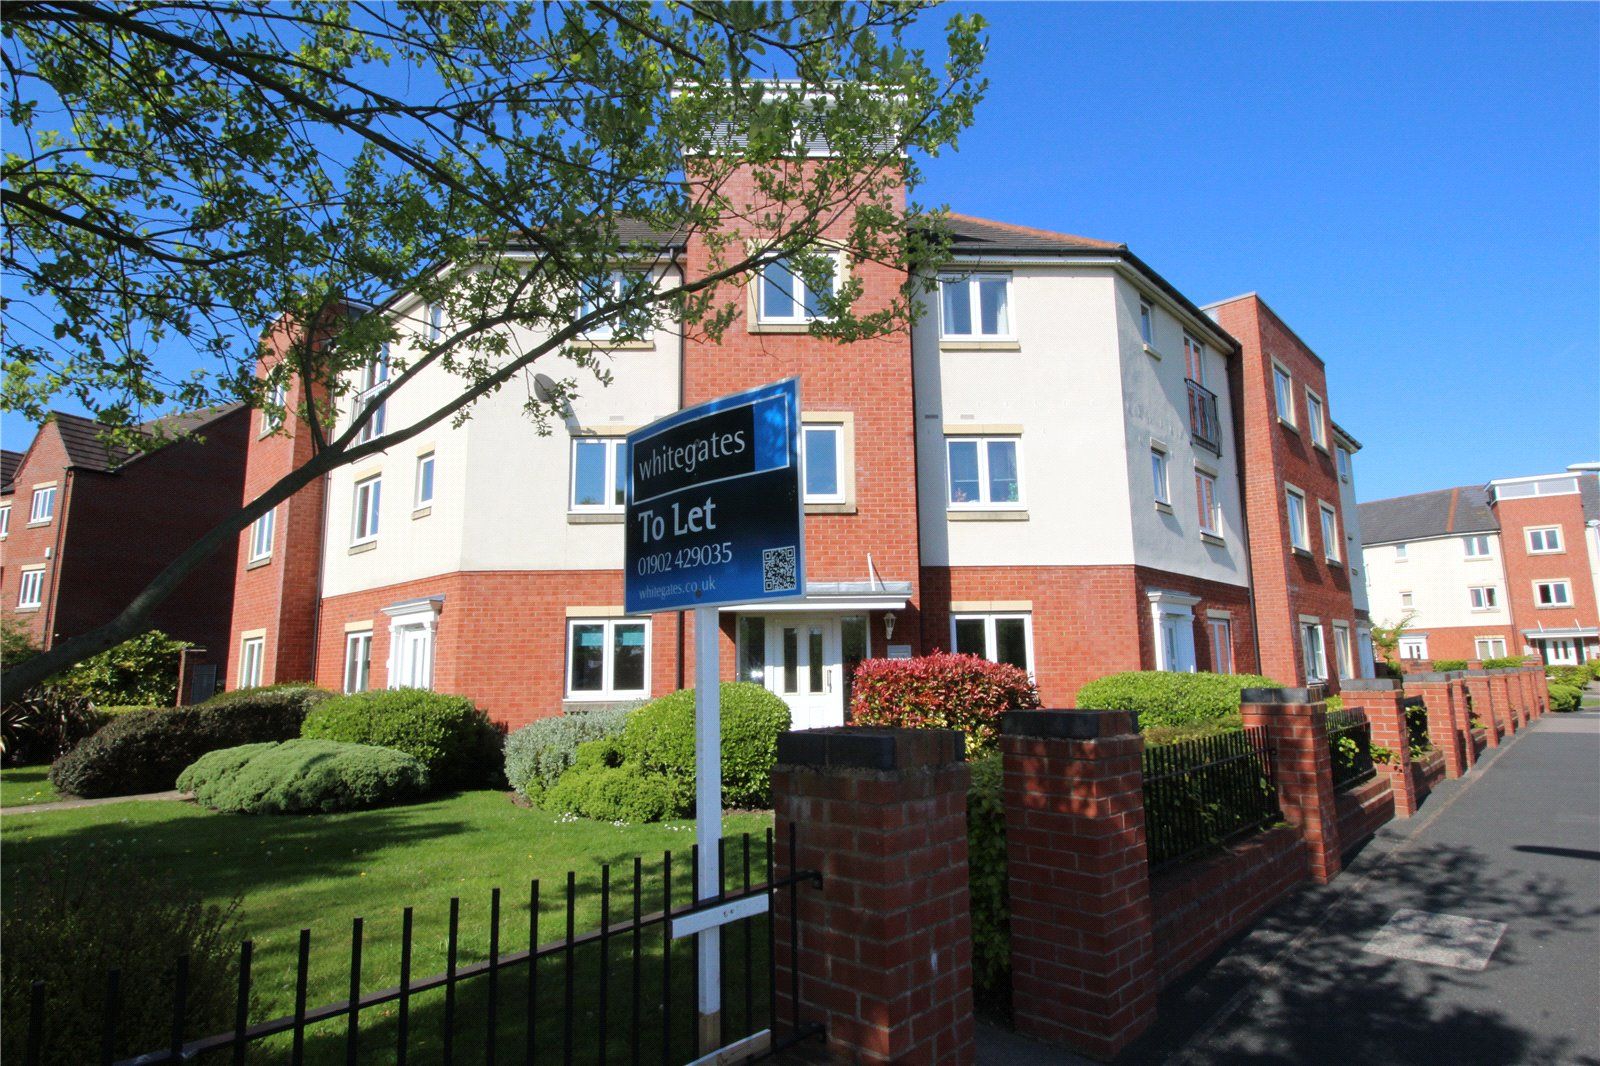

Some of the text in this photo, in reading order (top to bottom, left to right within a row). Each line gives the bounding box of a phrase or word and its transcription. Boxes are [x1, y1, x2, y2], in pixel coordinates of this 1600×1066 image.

[638, 430, 746, 481] whitegates
[638, 497, 716, 543] To Let
[637, 542, 732, 576] 01902 429035
[638, 575, 716, 600] whitegates.co.uk
